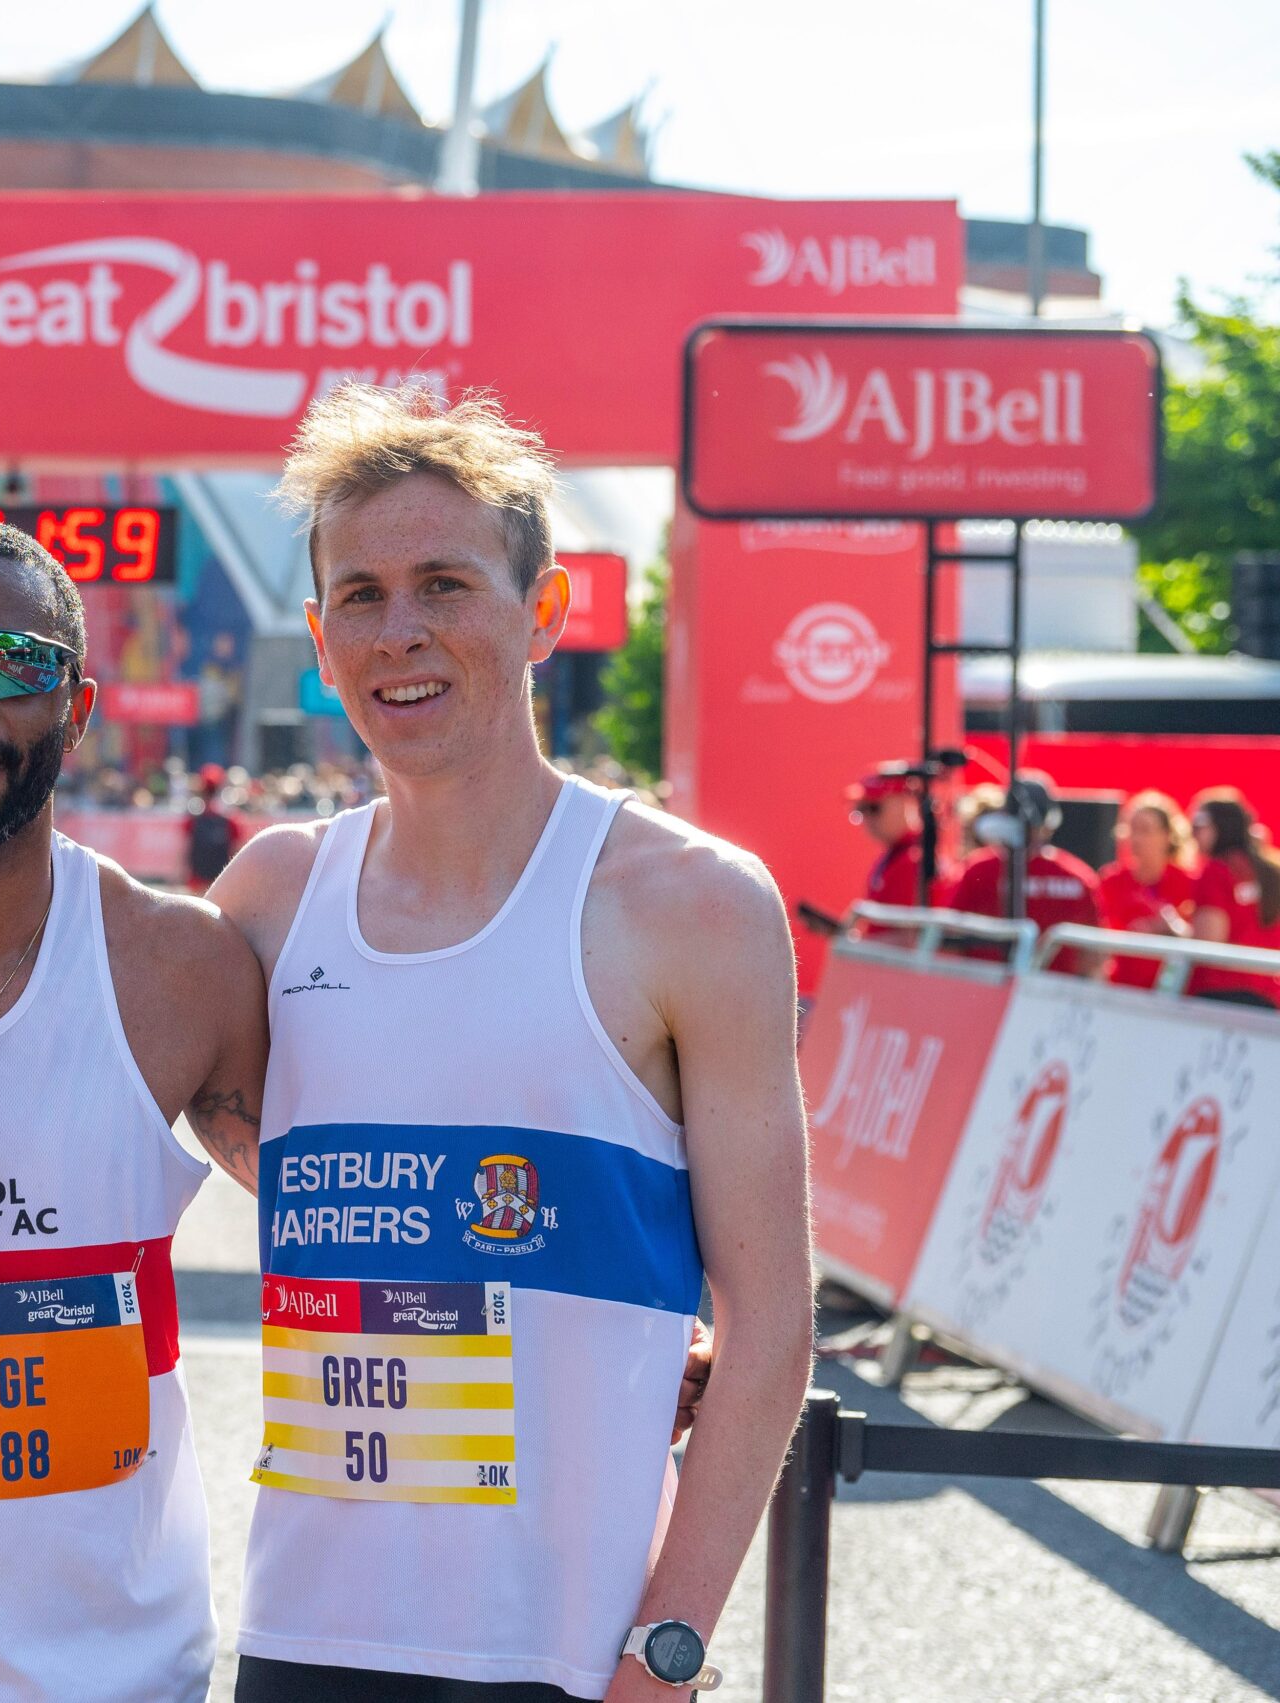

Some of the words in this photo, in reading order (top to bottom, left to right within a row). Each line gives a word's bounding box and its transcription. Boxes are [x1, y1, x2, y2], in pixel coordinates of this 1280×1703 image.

[789, 235, 936, 295] AJBell
[206, 259, 472, 348] bristol
[844, 368, 1083, 459] AJBell
[282, 983, 350, 996] RONHILL
[11, 1208, 59, 1236] AC
[27, 1289, 64, 1304] AJBell
[121, 1283, 135, 1314] 2025
[287, 1292, 338, 1320] AJBell
[393, 1291, 426, 1305] AJBell
[493, 1291, 505, 1325] 2025
[28, 1308, 54, 1322] great
[63, 1304, 95, 1317] bristol
[76, 1317, 92, 1325] run
[393, 1311, 417, 1323] great
[426, 1310, 458, 1321] bristol
[322, 1355, 407, 1410] GREG
[113, 1447, 142, 1470] 10K
[345, 1431, 388, 1483] 50
[478, 1464, 509, 1487] 10K
